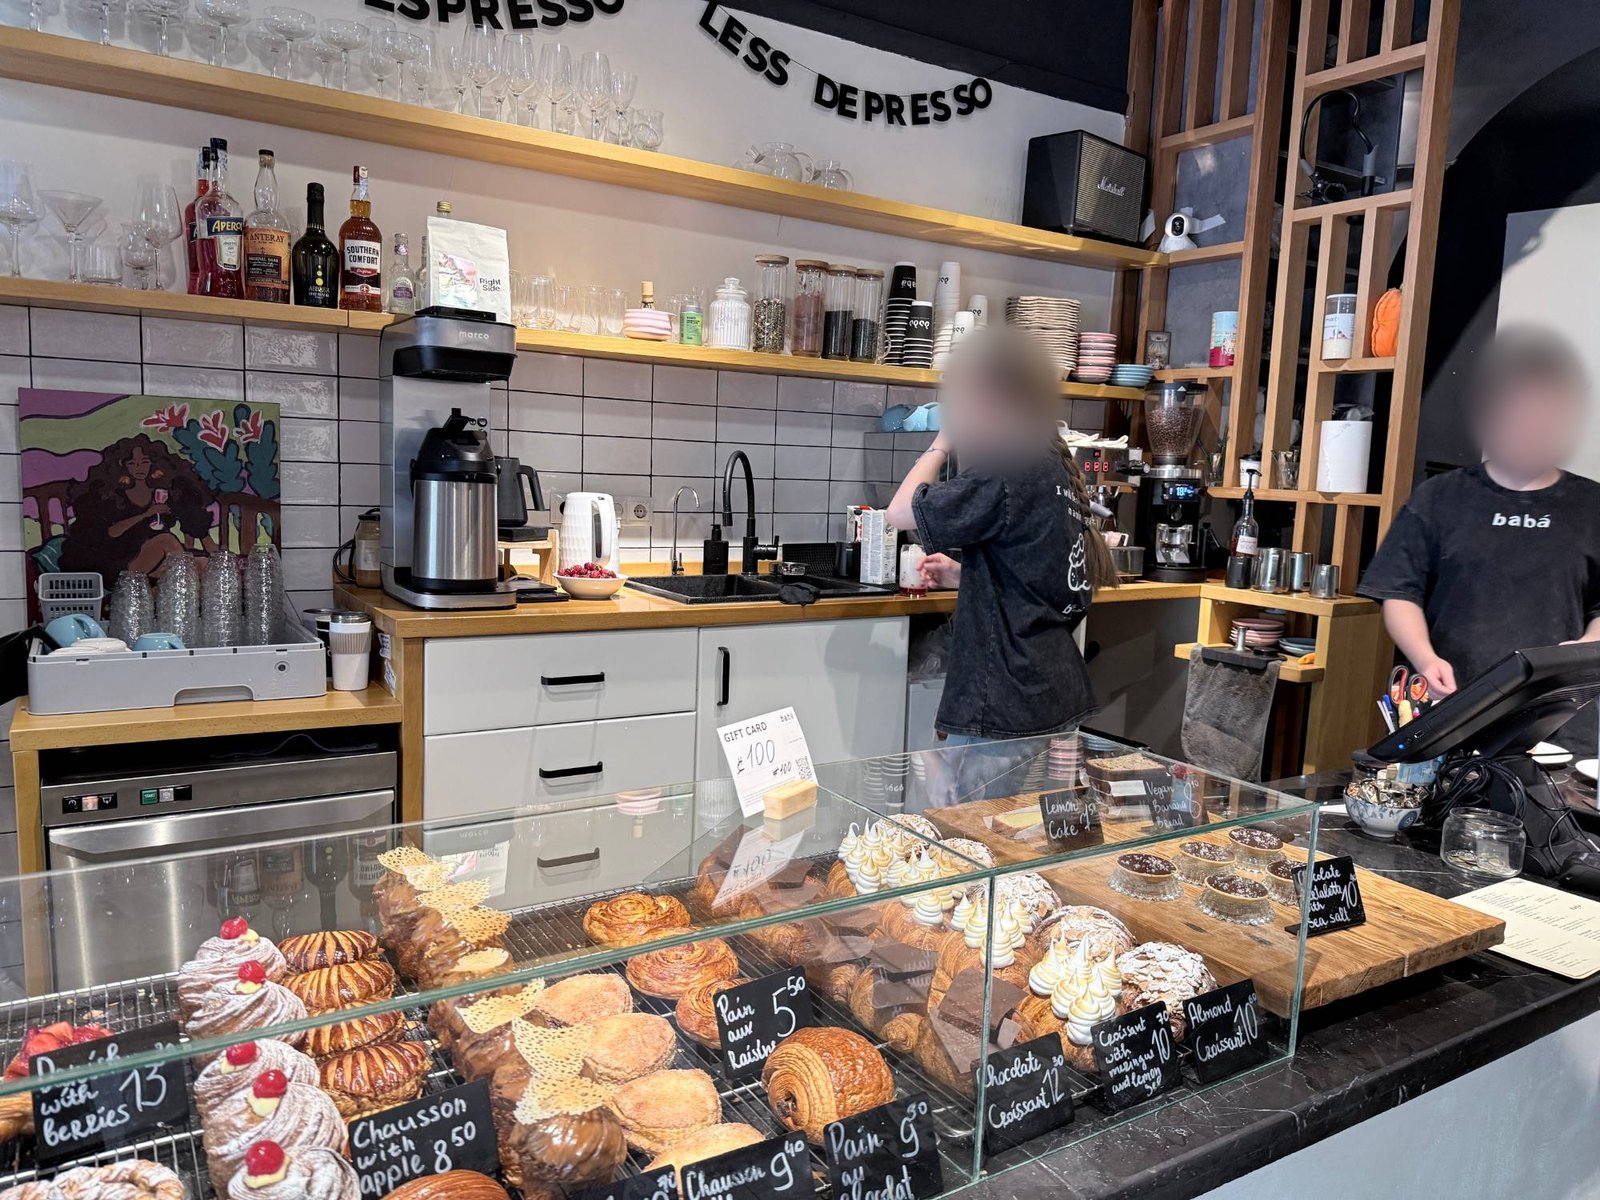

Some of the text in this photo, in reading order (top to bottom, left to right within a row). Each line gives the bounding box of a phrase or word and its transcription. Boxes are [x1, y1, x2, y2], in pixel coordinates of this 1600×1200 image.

[699, 0, 791, 86] LESS
[813, 77, 992, 126] DEPRESSO
[346, 246, 380, 257] SOUTHERN
[348, 254, 378, 265] COMFORT
[459, 331, 490, 340] marco
[1491, 512, 1551, 529] babá
[723, 721, 768, 743] GIFT CARD
[746, 739, 776, 769] 100
[1146, 782, 1174, 799] Vegan
[1045, 797, 1080, 816] Lemon
[1153, 799, 1188, 814] Banana
[1157, 814, 1185, 830] Bread
[1049, 821, 1079, 840] Cake
[1341, 881, 1358, 909] 10
[1329, 906, 1351, 923] salt
[716, 975, 806, 1037] Pain 5 50
[1187, 993, 1233, 1030] Almond
[1233, 1002, 1258, 1045] 10
[727, 1021, 753, 1043] aux
[1099, 1016, 1146, 1047] Croissant
[1151, 1027, 1171, 1064] 10
[1195, 1025, 1247, 1062] Croissant
[1105, 1042, 1132, 1064] with
[40, 1083, 99, 1116] with
[1042, 1067, 1065, 1105] 12
[353, 1097, 477, 1149] Chausson 50
[988, 1086, 1051, 1129] Croissant
[43, 1103, 131, 1147] berries
[828, 1121, 884, 1165] Pain
[900, 1116, 920, 1158] 9
[356, 1135, 453, 1174] with 8
[686, 1165, 766, 1200] Chausson
[784, 1139, 805, 1157] 40
[360, 1154, 426, 1197] apple
